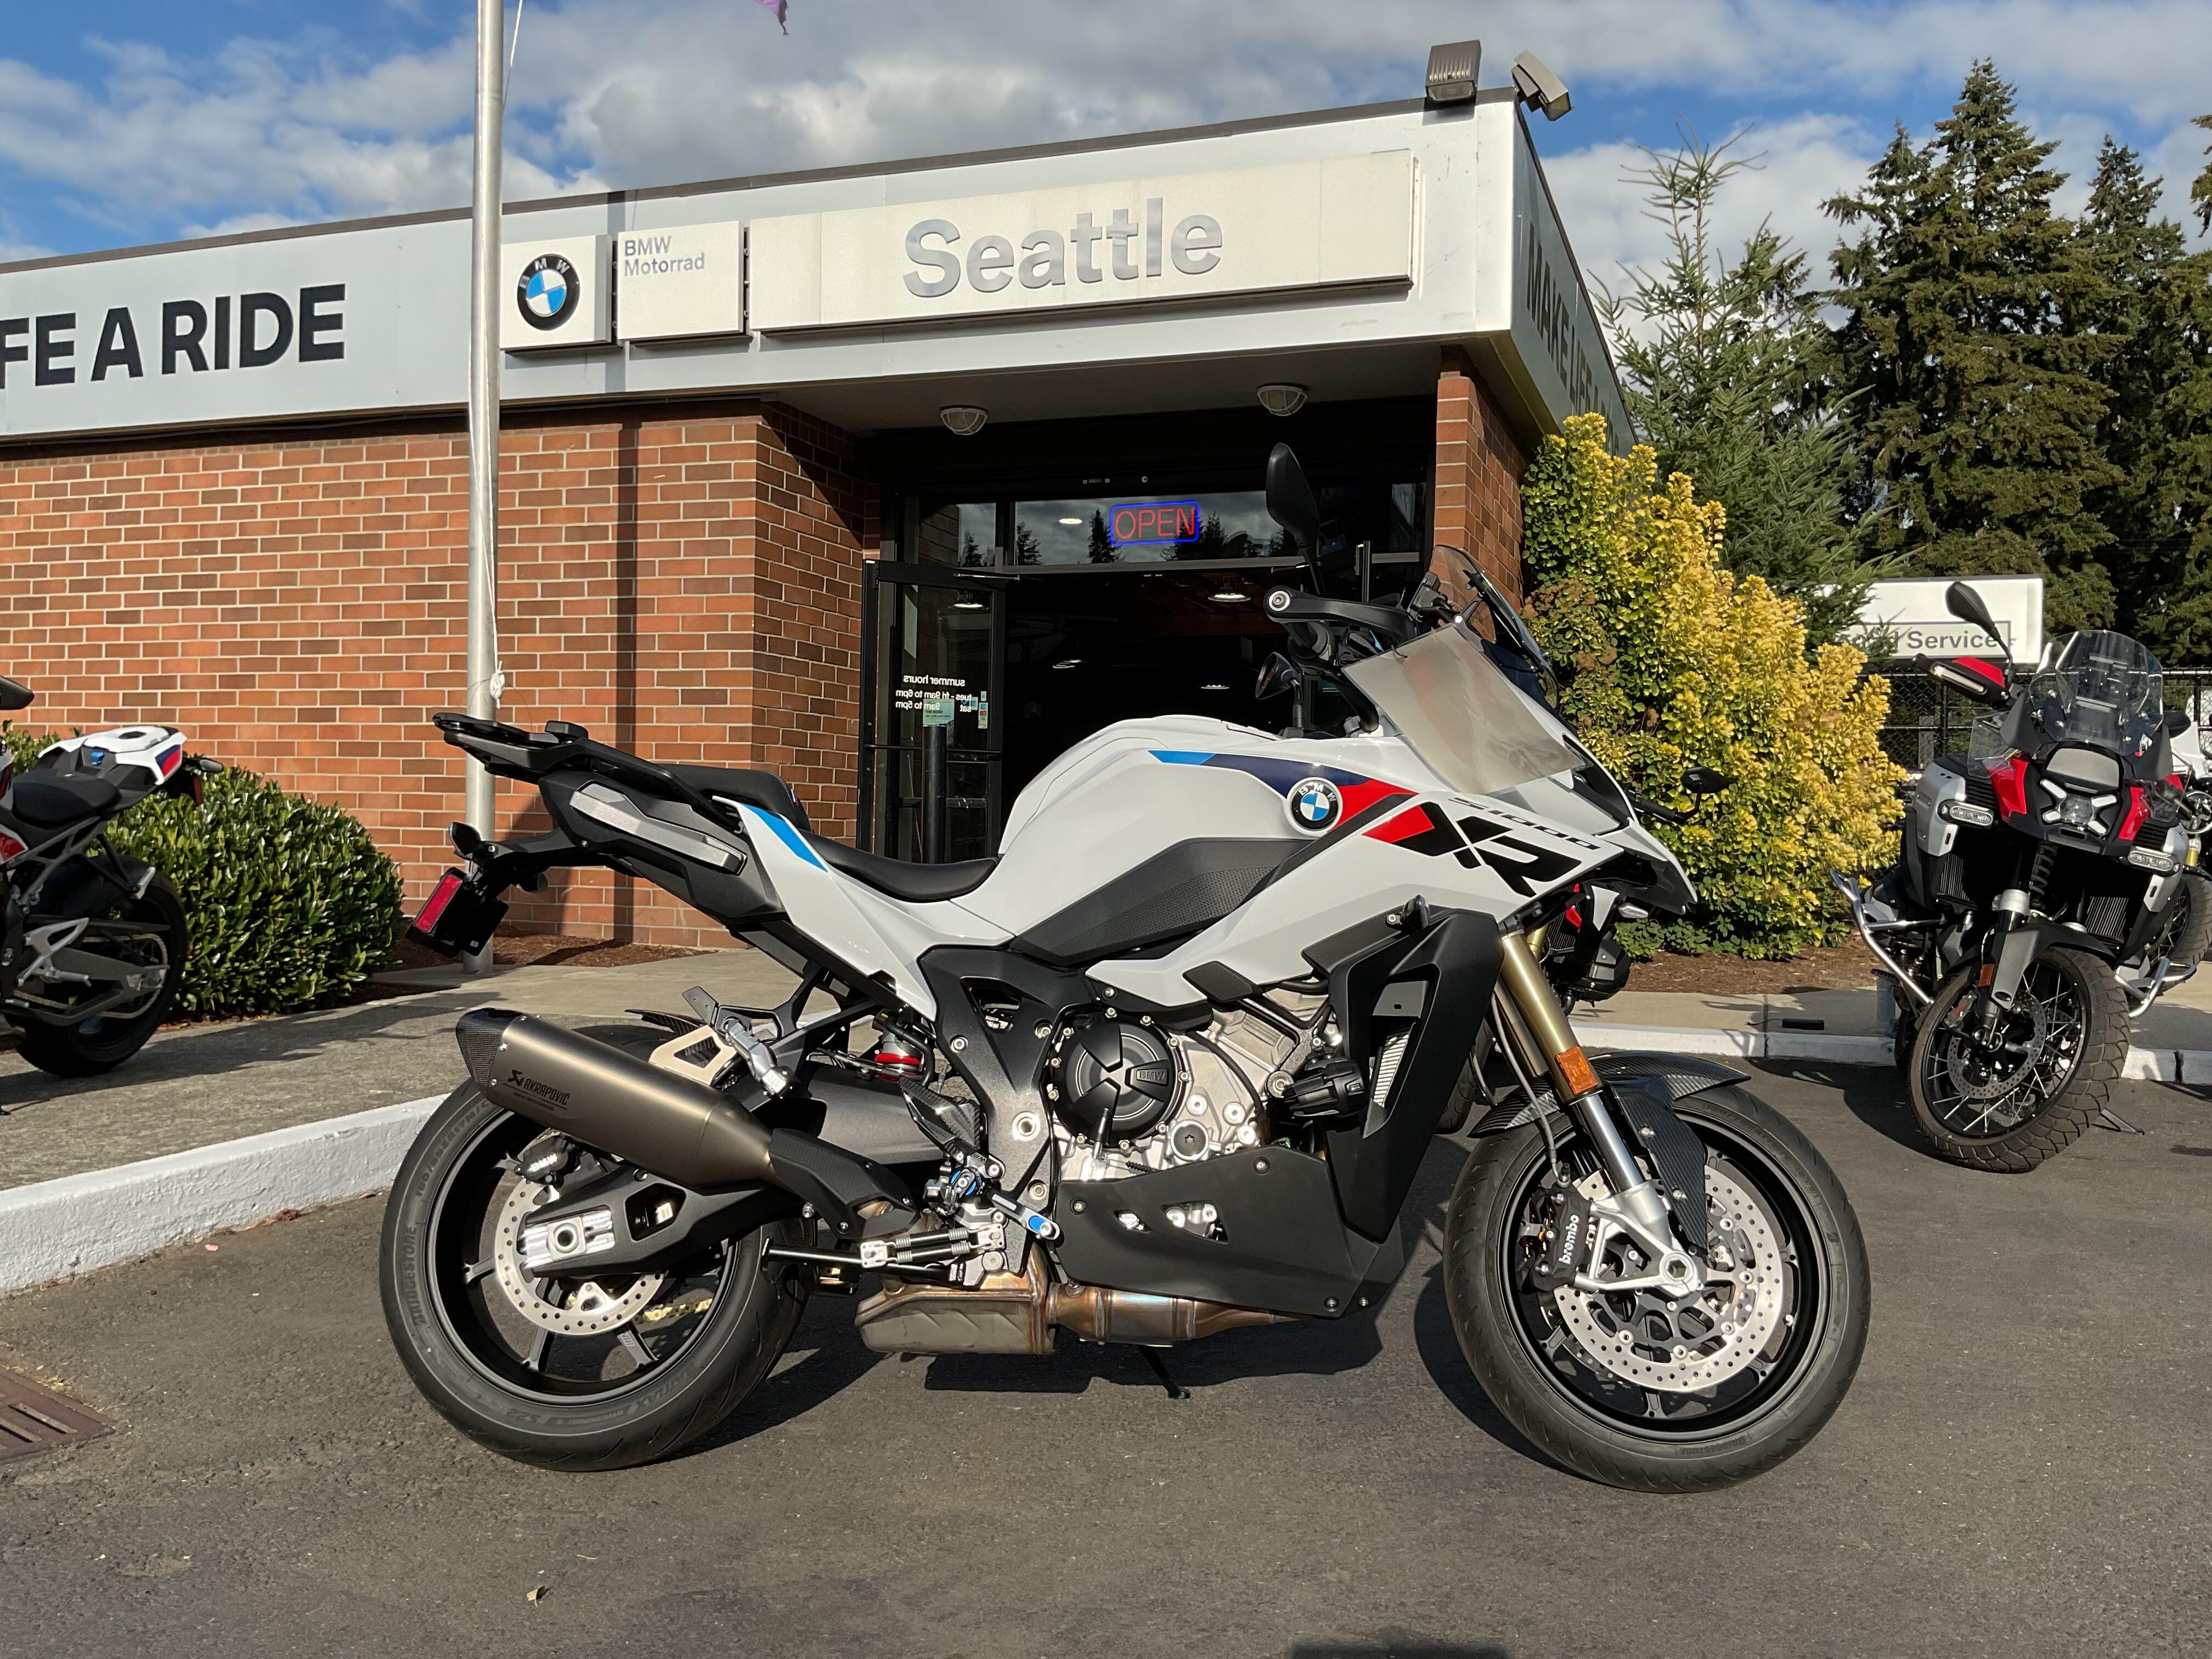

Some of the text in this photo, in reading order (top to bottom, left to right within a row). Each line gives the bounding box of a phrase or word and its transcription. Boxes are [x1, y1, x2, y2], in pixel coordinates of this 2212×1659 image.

[625, 235, 672, 257] BMW
[903, 197, 1223, 298] Seattle
[519, 257, 570, 289] BMW
[624, 252, 705, 276] Motorrad
[1526, 219, 1570, 390] MAKE
[91, 307, 144, 382] A
[161, 283, 346, 375] RIDE
[1114, 507, 1195, 540] OPEN
[1906, 630, 1998, 650] Service
[1298, 782, 1337, 803] BMW
[1140, 1071, 1165, 1080] BMW
[1558, 1214, 1580, 1265] brembo
